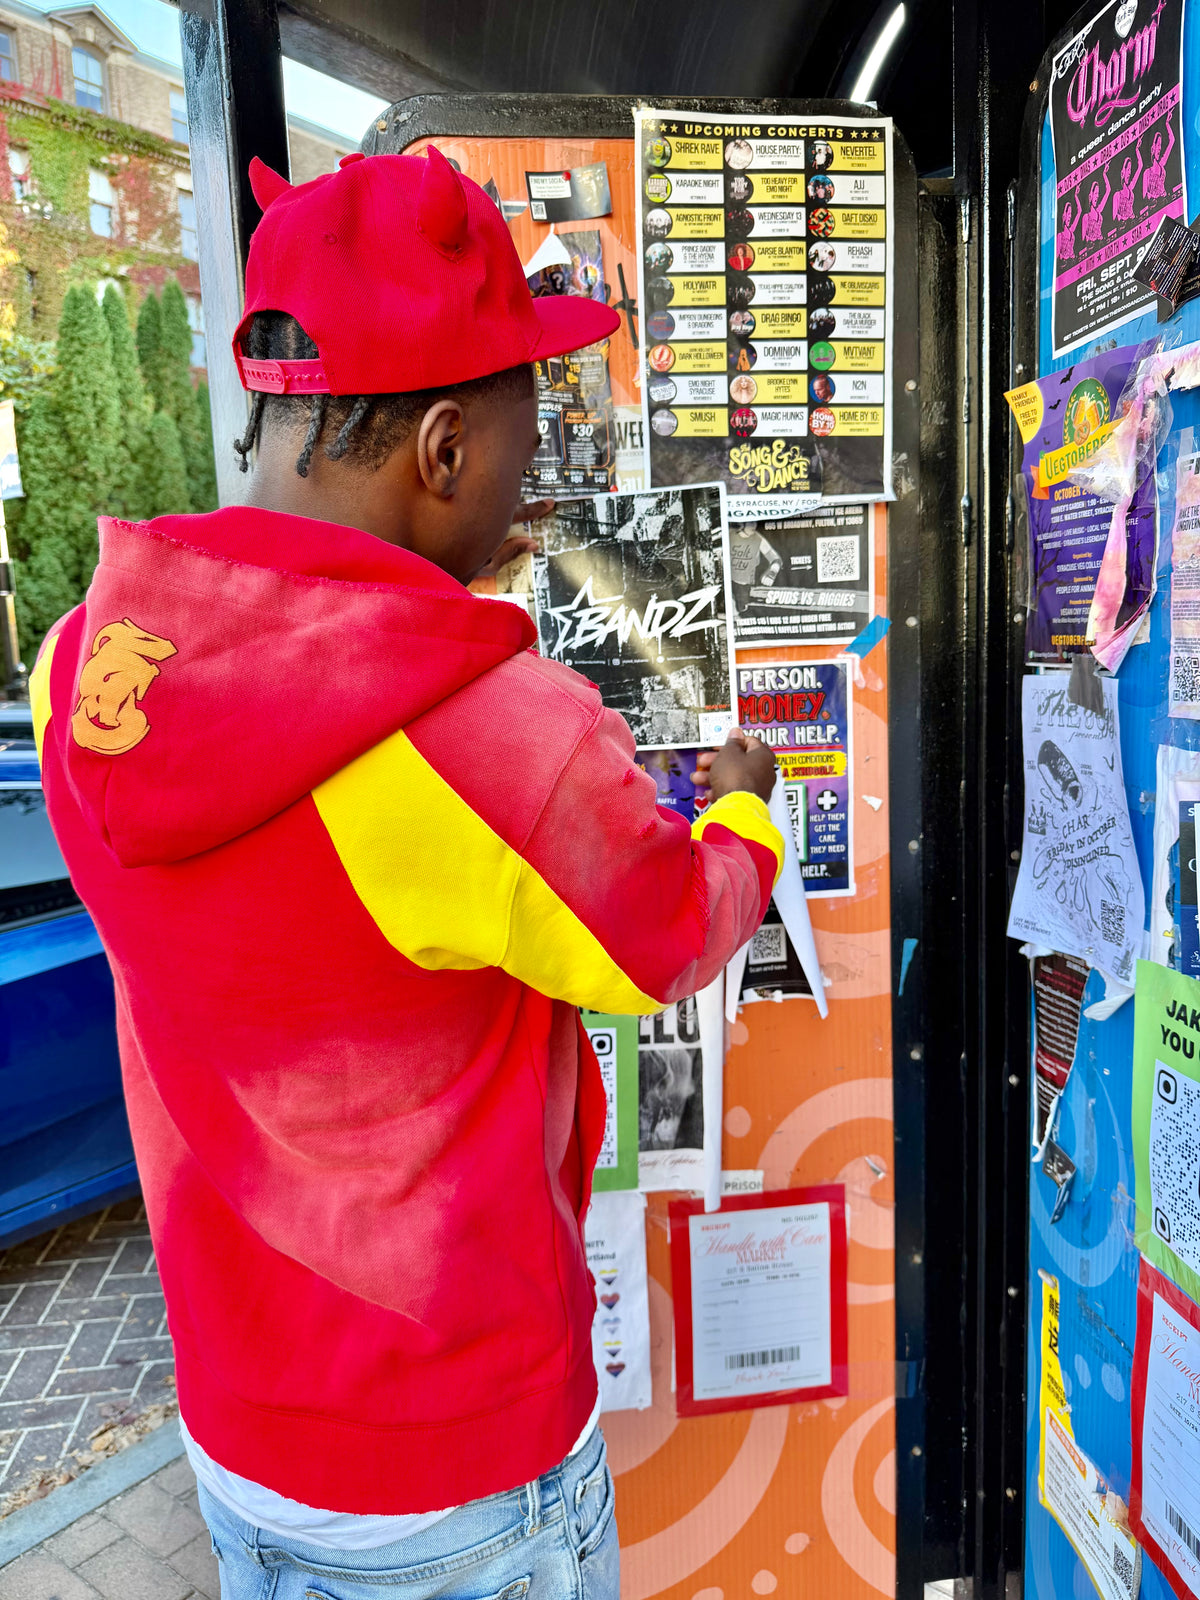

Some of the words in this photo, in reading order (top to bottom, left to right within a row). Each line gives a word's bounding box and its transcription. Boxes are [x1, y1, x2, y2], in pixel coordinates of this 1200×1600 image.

[1070, 156, 1076, 164] a
[1078, 133, 1104, 158] queer
[1108, 108, 1136, 134] dance
[1138, 82, 1162, 112] party
[684, 124, 761, 136] UPCOMING
[768, 127, 844, 138] CONCERTS
[675, 142, 700, 154] SHREK
[700, 143, 720, 154] RAVE
[756, 145, 778, 154] HOUSE
[779, 145, 802, 154] PARTY:
[840, 146, 877, 156] NEVERTEL
[676, 180, 702, 188] KARAOKE
[702, 180, 720, 188] NIGHT
[676, 214, 702, 222] AGNOSTIC
[703, 214, 722, 222] FRONT
[758, 212, 794, 220] WEDNESDAY
[842, 214, 858, 222] DAFT
[858, 214, 878, 222] DISKO
[848, 246, 872, 255] REHASH
[1100, 253, 1132, 282] SEPT
[683, 281, 716, 290] HOLYWATR
[1082, 291, 1094, 302] THE
[1095, 280, 1114, 296] SONG
[1090, 308, 1094, 316] 9
[1096, 302, 1106, 312] PM
[1126, 285, 1138, 296] $10
[761, 314, 780, 322] DRAG
[780, 313, 802, 322] BINGO
[764, 346, 800, 356] DOMINION
[844, 347, 876, 356] MVTVANT
[1012, 392, 1028, 401] FAMILY
[690, 412, 716, 422] SMUSH
[761, 412, 781, 420] MAGIC
[782, 412, 804, 420] HUNKS
[839, 412, 859, 421] HOME
[860, 412, 869, 421] BY
[1020, 411, 1030, 420] FREE
[572, 424, 594, 437] $30
[729, 446, 772, 475] SONG
[540, 473, 557, 481] $200
[755, 462, 808, 492] DANCE
[1054, 486, 1081, 501] OCTOBER
[736, 500, 780, 508] SYRACUSE,
[732, 545, 751, 558] Salt
[766, 590, 800, 605] SPUDS
[801, 592, 816, 606] VS.
[817, 593, 856, 606] RIGGIES
[572, 584, 727, 652] BANDZ
[819, 613, 832, 622] FREE
[739, 666, 823, 692] PERSON.
[738, 692, 830, 724] MONEY.
[795, 724, 840, 746] HELP.
[798, 754, 836, 765] CONDITIONS
[782, 768, 789, 778] A
[810, 814, 826, 822] HELP
[828, 813, 845, 821] THEM
[814, 824, 826, 832] GET
[828, 823, 840, 831] THE
[819, 833, 836, 842] CARE
[1076, 837, 1086, 849] IN
[1087, 817, 1116, 845] OCTOBER
[810, 845, 828, 854] THEY
[828, 845, 845, 853] NEED
[802, 864, 829, 878] HELP.
[1161, 1024, 1194, 1059] YOU
[736, 1248, 786, 1265] MARKET
[1162, 1314, 1188, 1342] RECEIPT
